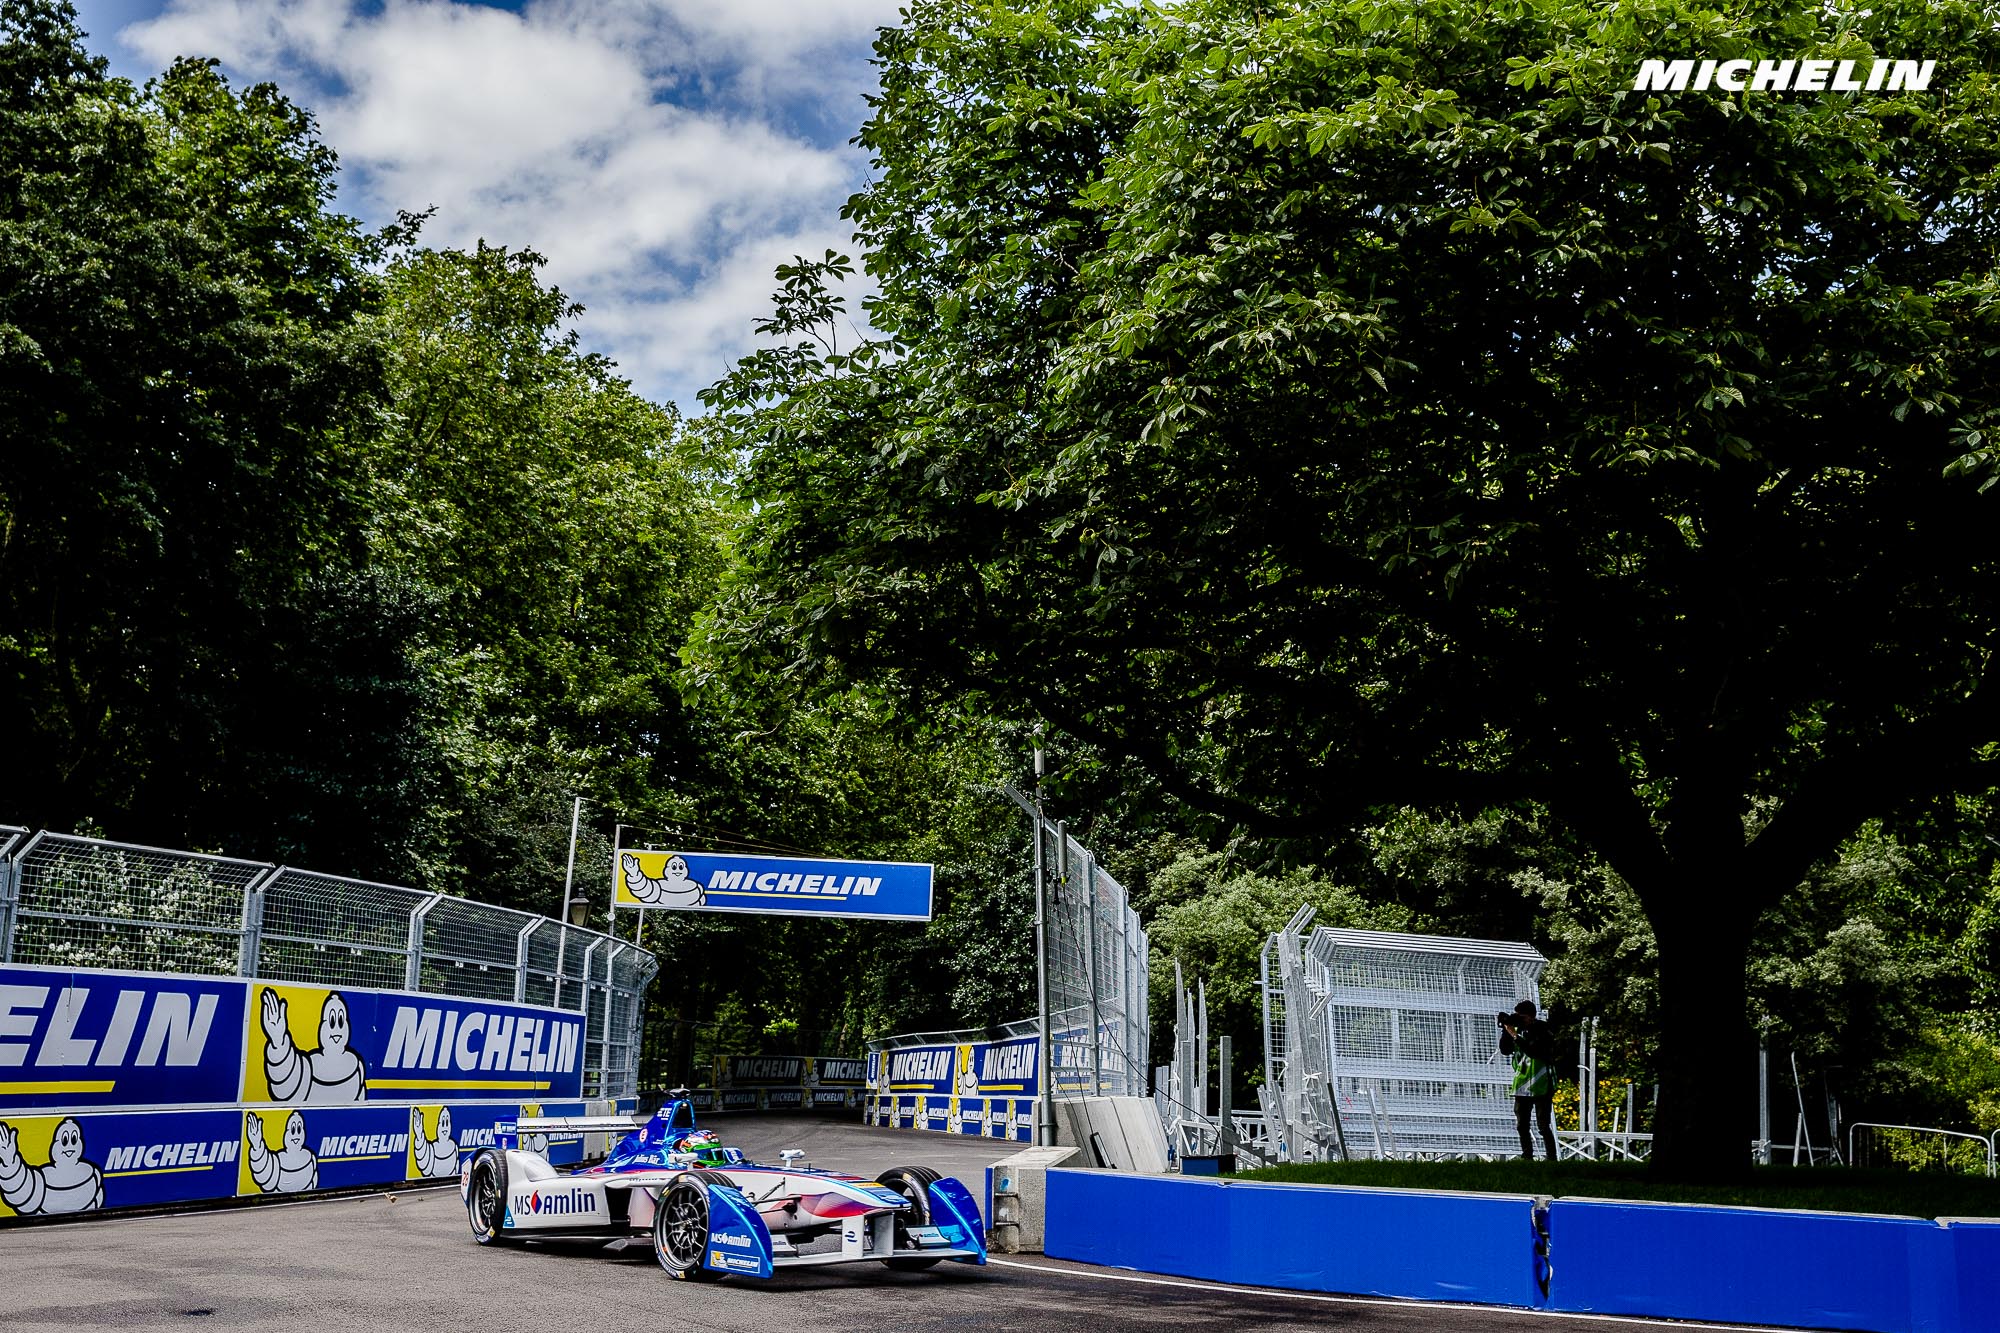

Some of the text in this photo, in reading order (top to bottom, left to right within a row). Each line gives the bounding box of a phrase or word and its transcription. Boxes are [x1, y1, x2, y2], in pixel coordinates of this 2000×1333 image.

[708, 870, 882, 896] MICHELIN
[382, 1006, 580, 1073] MICHELIN
[736, 1059, 799, 1078] MICHELIN
[891, 1051, 951, 1081] MICHELIN
[981, 1043, 1037, 1081] MICHELIN
[814, 1092, 844, 1103] MICHELIN
[104, 1140, 240, 1171] MICHELIN
[318, 1133, 408, 1157] MICHELIN
[514, 1195, 531, 1216] MS
[711, 1232, 722, 1244] MS
